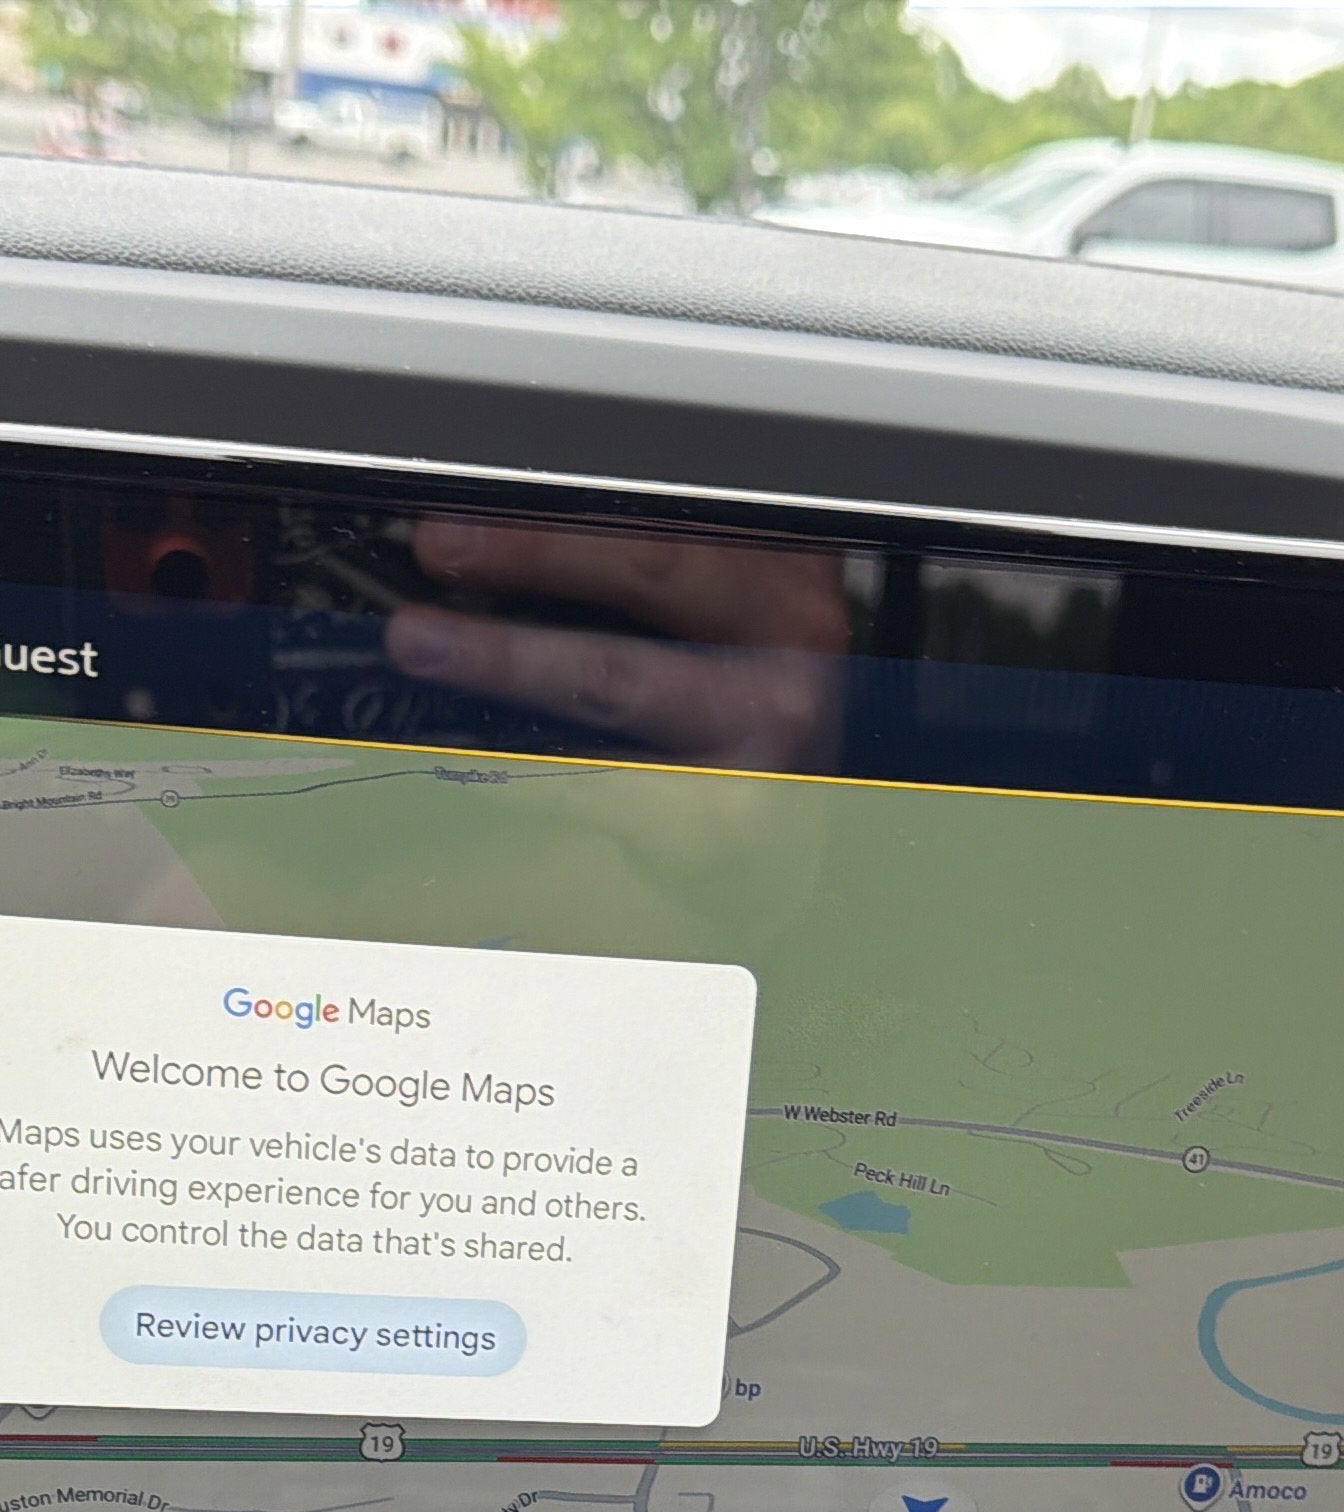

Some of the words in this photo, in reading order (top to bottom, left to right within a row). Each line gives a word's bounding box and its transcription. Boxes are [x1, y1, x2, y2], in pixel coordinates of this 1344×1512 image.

[223, 987, 340, 1029] Google
[348, 997, 431, 1034] Maps
[91, 1049, 263, 1091] Welcome
[274, 1062, 309, 1093] to
[320, 1064, 451, 1107] Google
[461, 1072, 555, 1113] Maps
[784, 1105, 802, 1120] W
[804, 1106, 872, 1126] Webster
[874, 1111, 897, 1127] Rd
[89, 1129, 162, 1152] uses
[170, 1131, 241, 1160] your
[249, 1132, 381, 1164] vehicle's
[390, 1138, 456, 1168] data
[465, 1143, 494, 1171] to
[502, 1147, 613, 1178] provide
[621, 1157, 638, 1178] a
[854, 1162, 895, 1185] Peck
[898, 1172, 928, 1191] Hill
[930, 1179, 951, 1197] Ln
[71, 1167, 177, 1206] driving
[188, 1176, 360, 1208] experience
[369, 1181, 411, 1211] for
[419, 1191, 472, 1218] you
[482, 1190, 535, 1217] and
[545, 1192, 646, 1222] others.
[57, 1212, 112, 1242] You
[122, 1219, 228, 1248] control
[239, 1221, 287, 1250] the
[297, 1224, 363, 1253] data
[373, 1228, 455, 1258] that's
[464, 1232, 573, 1263] shared.
[136, 1312, 246, 1341] Review
[255, 1316, 368, 1351] privacy
[375, 1323, 497, 1357] settings
[734, 1378, 761, 1401] bp
[370, 1436, 394, 1452] 19
[798, 1435, 844, 1458] U.S.
[851, 1437, 905, 1462] Hwy
[910, 1436, 940, 1459] 19
[1311, 1443, 1333, 1460] 19
[56, 1486, 144, 1508] Memorial
[517, 1489, 538, 1507] Dr
[1228, 1481, 1307, 1501] Amoco
